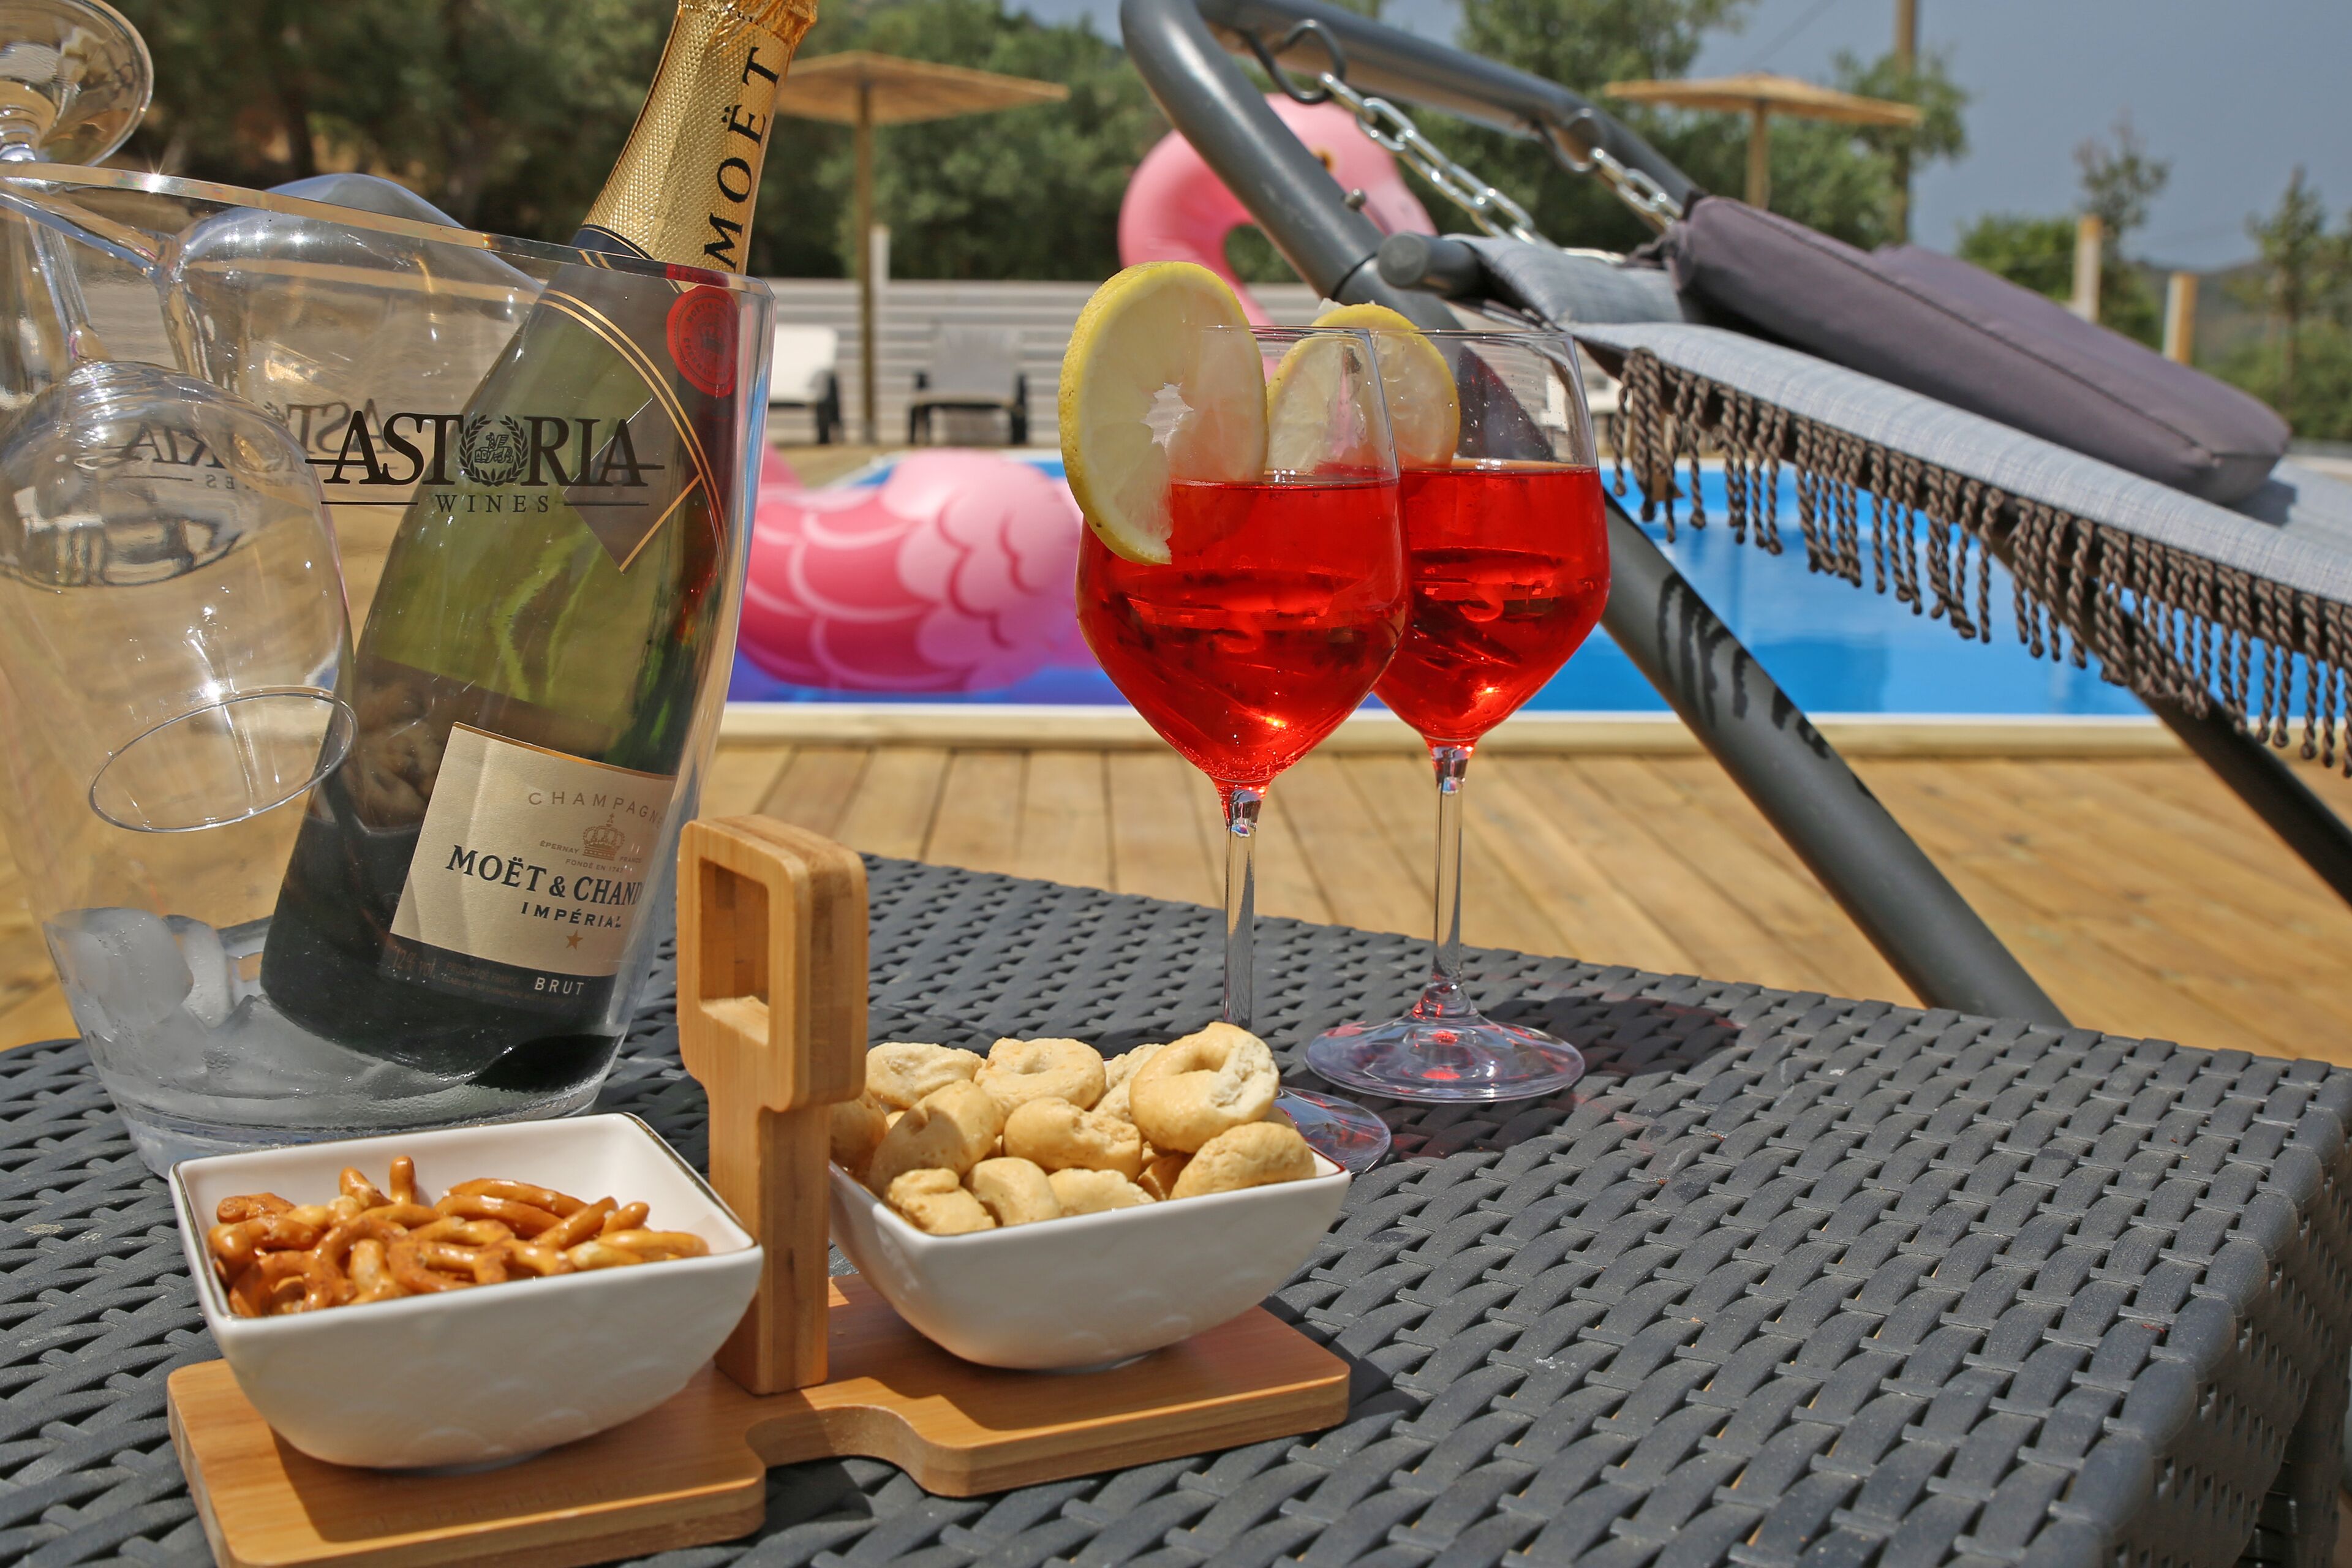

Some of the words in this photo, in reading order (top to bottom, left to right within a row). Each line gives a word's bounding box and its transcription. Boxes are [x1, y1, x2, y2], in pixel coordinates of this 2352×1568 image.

[704, 47, 780, 274] MOËT
[435, 494, 549, 513] WINES
[445, 845, 547, 892] MOËT
[548, 875, 566, 898] &
[565, 858, 594, 869] FONDÉ
[521, 902, 622, 929] IMPÉRIAL
[534, 977, 585, 995] BRUT
